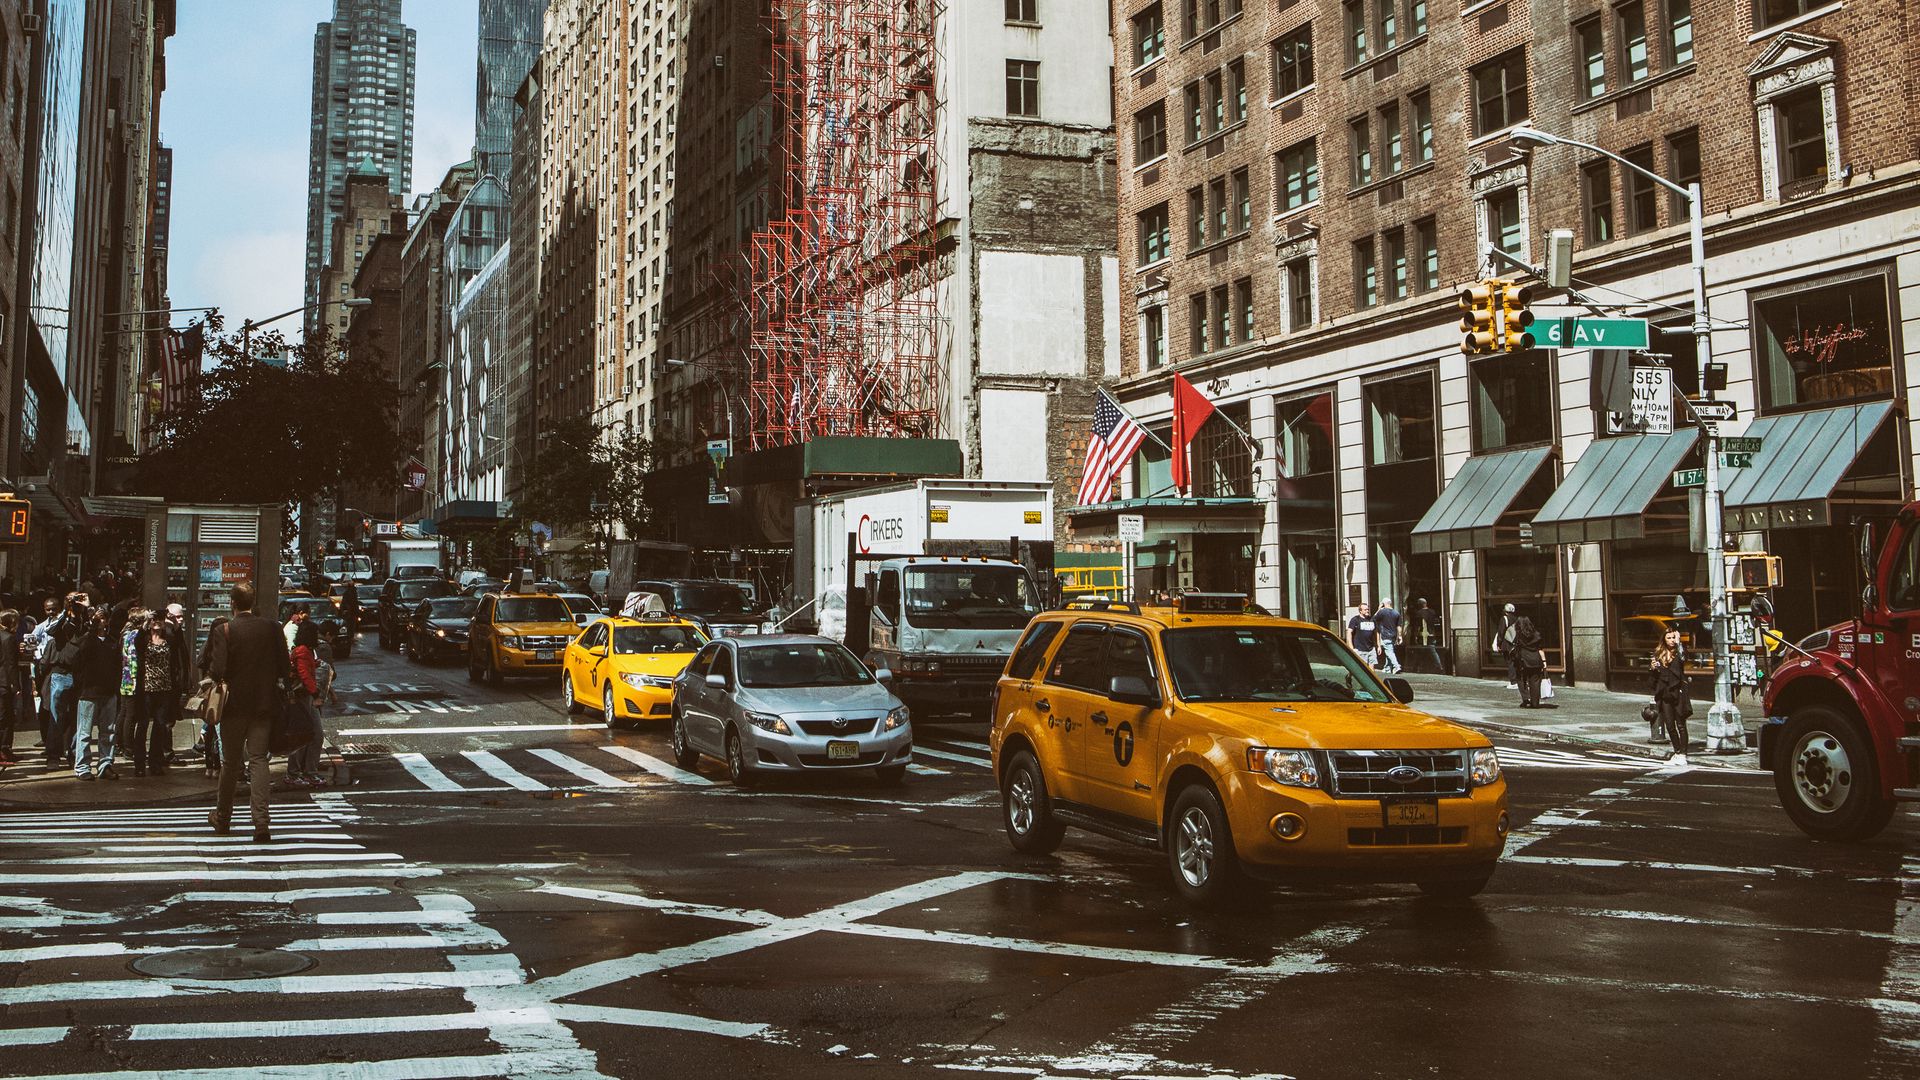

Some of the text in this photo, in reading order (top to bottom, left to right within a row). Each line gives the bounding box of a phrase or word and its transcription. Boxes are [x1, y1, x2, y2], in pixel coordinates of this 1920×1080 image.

[1548, 324, 1605, 342] 6 Av
[1629, 371, 1663, 385] USES
[1631, 388, 1657, 401] NLY
[1694, 407, 1731, 415] ONE WAY
[1727, 442, 1760, 451] AMERICAS
[106, 456, 140, 464] VICEROY
[1733, 455, 1740, 467] 6
[1688, 471, 1697, 484] 57
[11, 510, 27, 537] 13
[858, 514, 904, 554] CIRKERS
[150, 519, 160, 564] Newsstand
